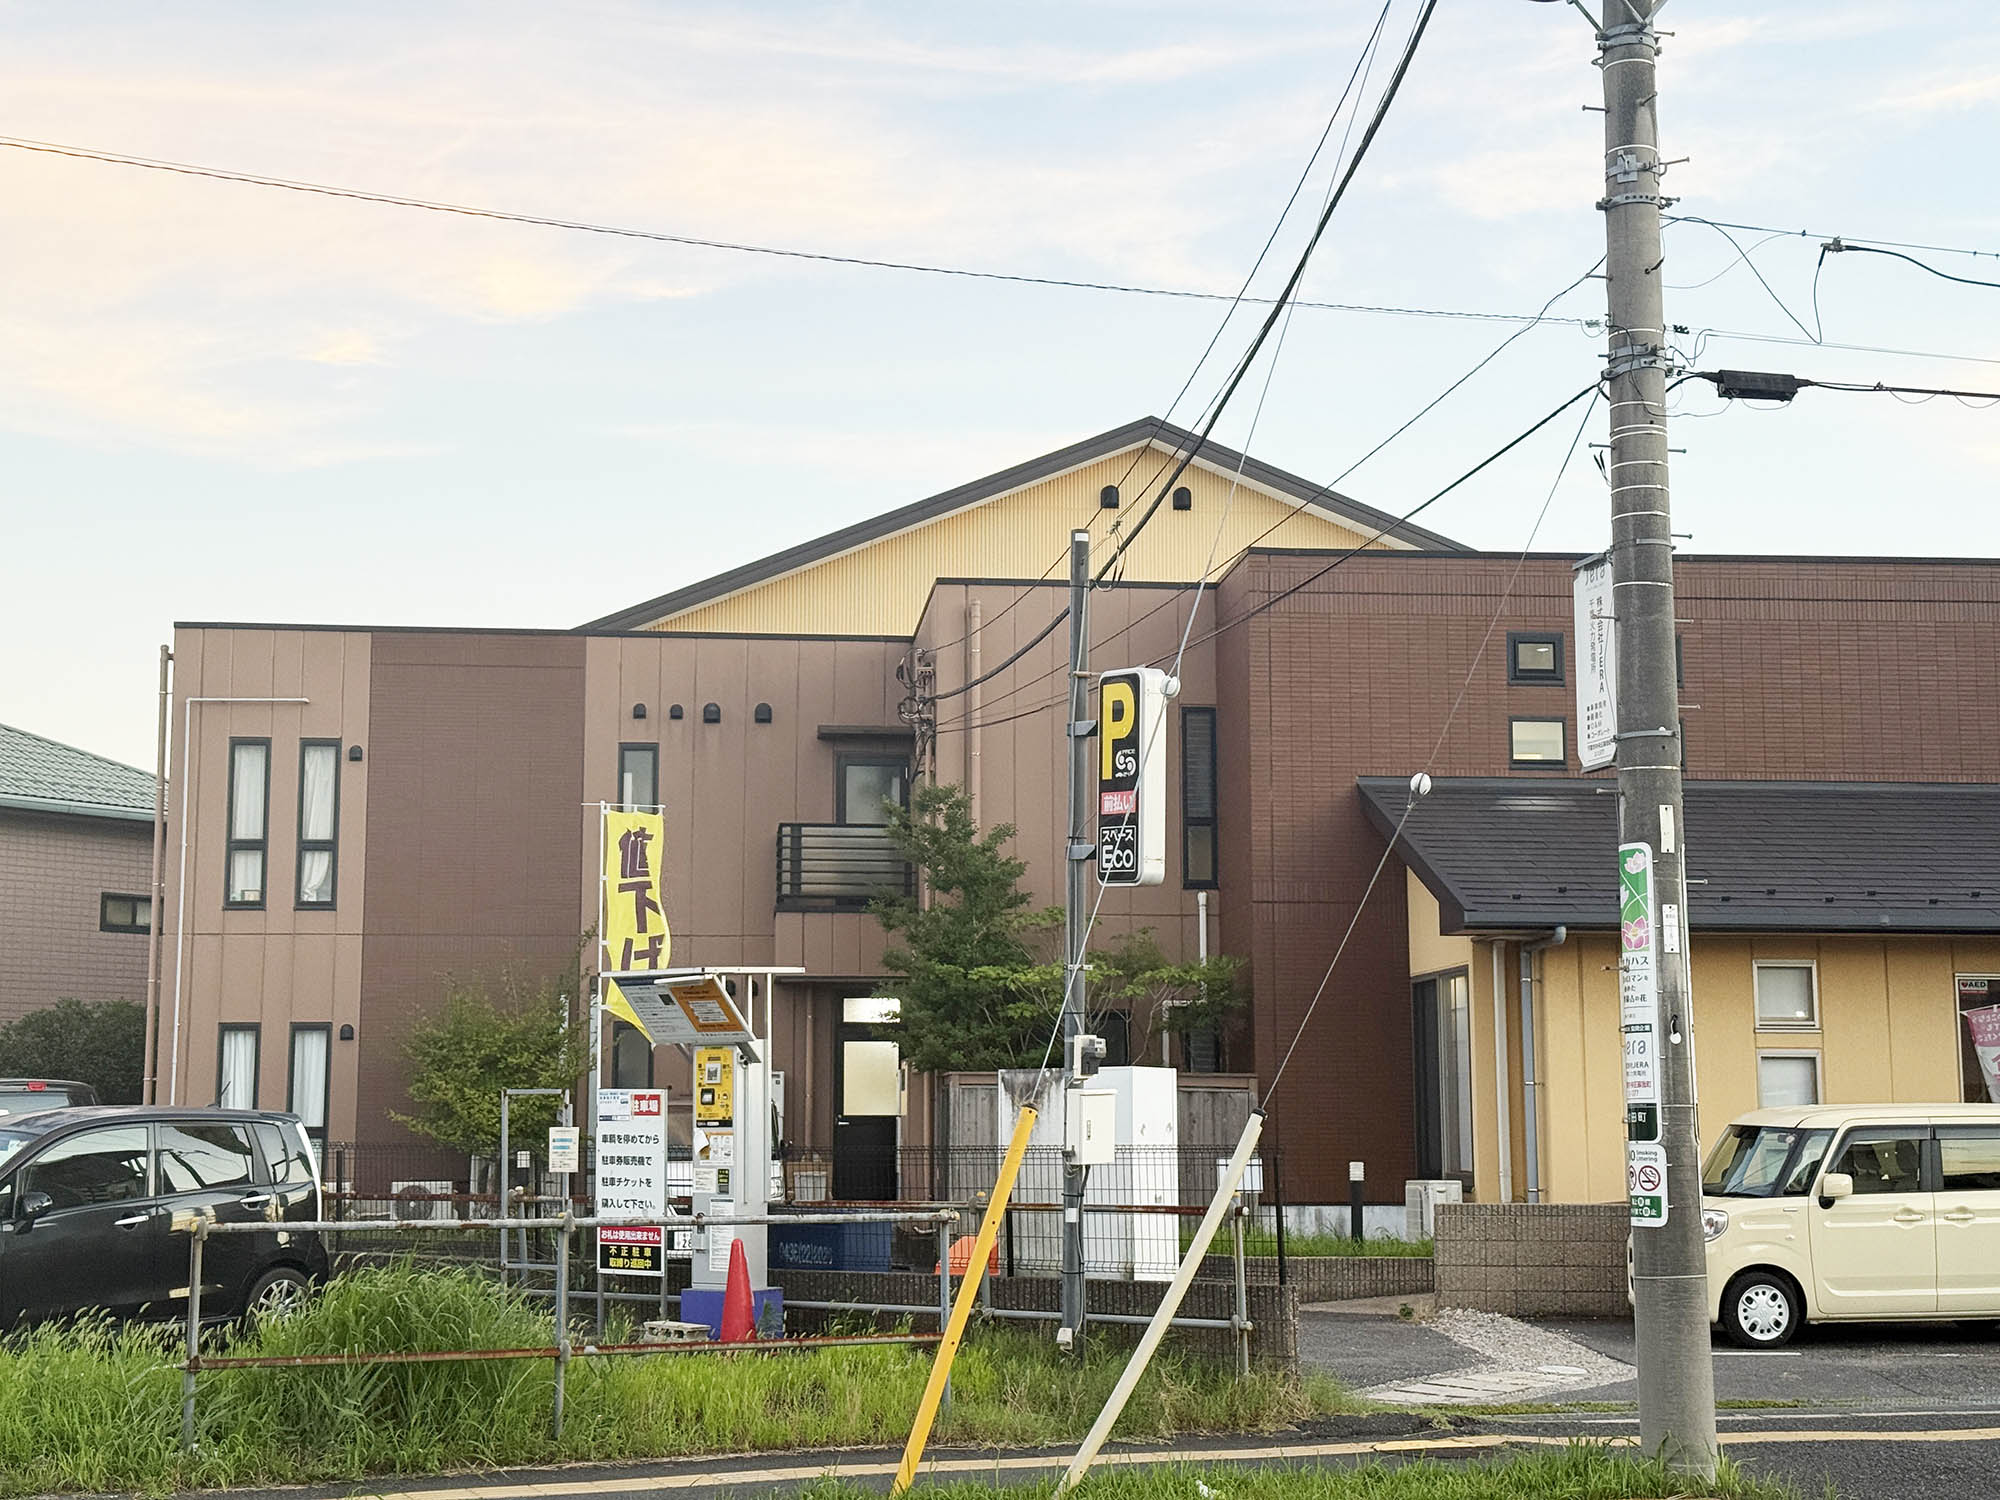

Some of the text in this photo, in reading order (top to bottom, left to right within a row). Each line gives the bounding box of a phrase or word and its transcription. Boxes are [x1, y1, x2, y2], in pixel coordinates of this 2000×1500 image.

[1102, 682, 1135, 780] P
[1103, 794, 1135, 812] 前払い
[1102, 829, 1134, 842] スペース
[618, 827, 665, 970] 値下げ
[601, 1155, 653, 1166] 駐車券販売機で
[601, 1177, 652, 1188] 駐車チケットを
[600, 1229, 660, 1241] お札は使用出来ません
[609, 1245, 652, 1257] 不正駐車
